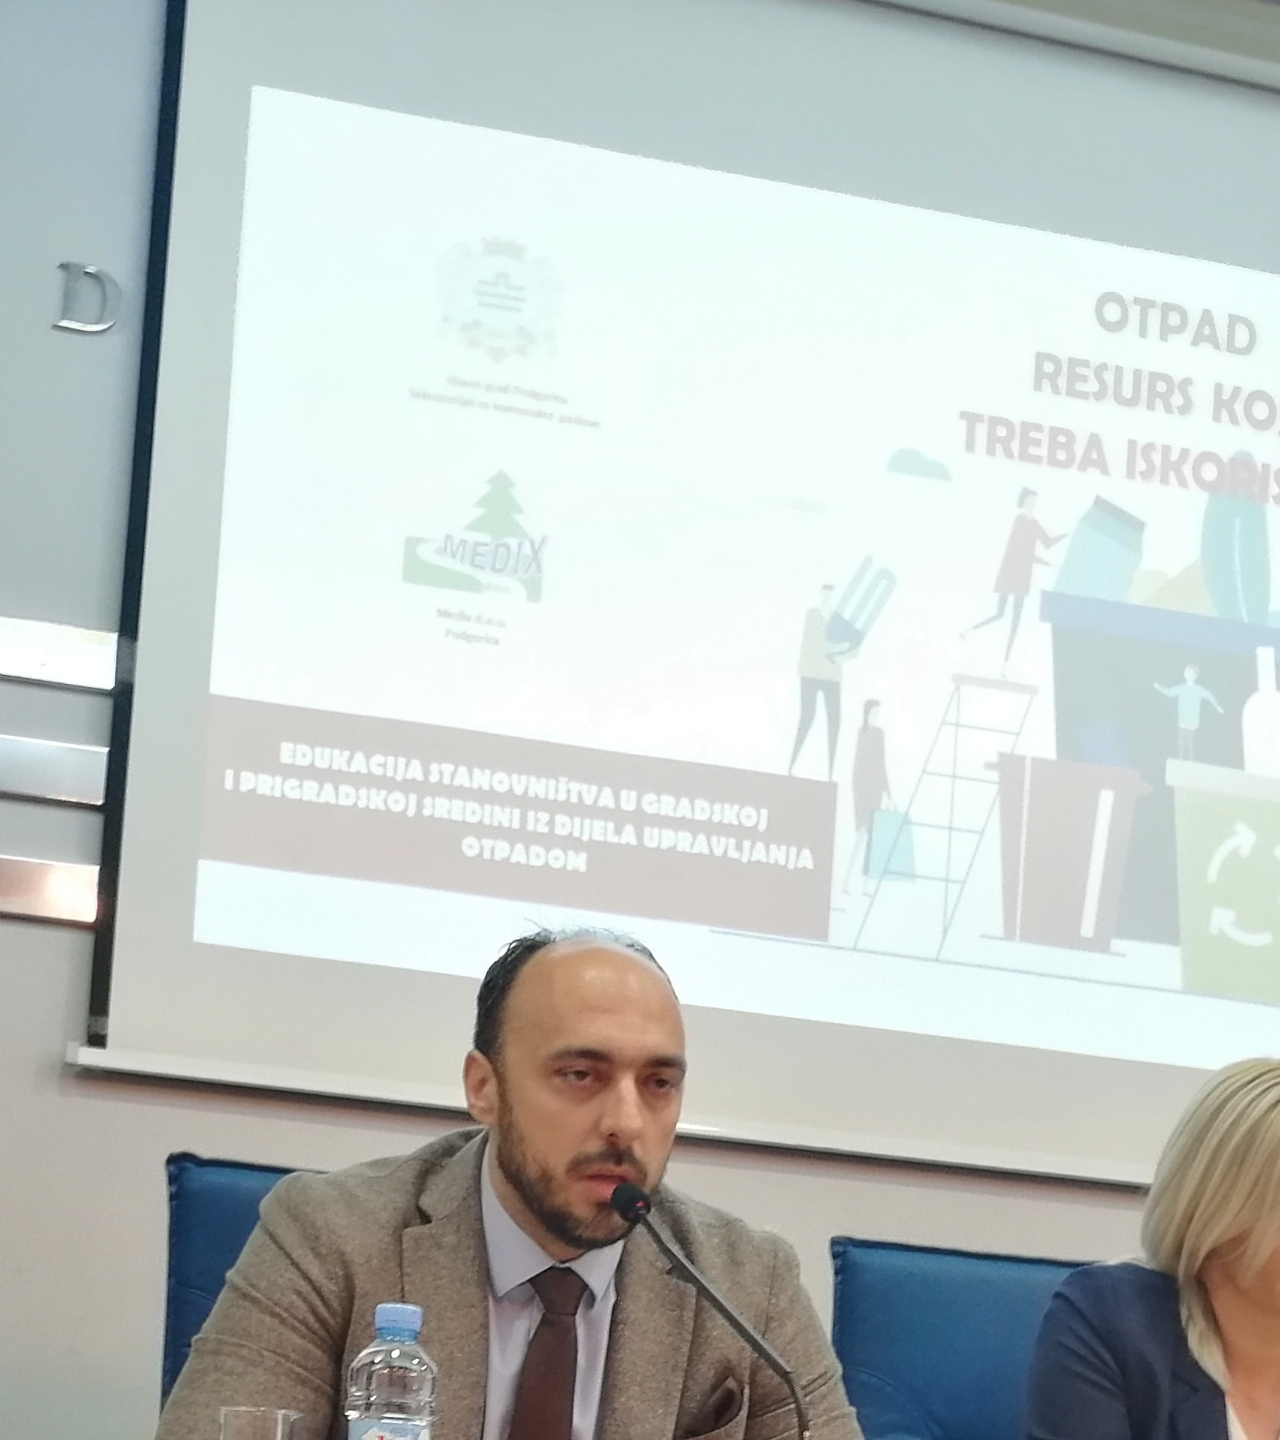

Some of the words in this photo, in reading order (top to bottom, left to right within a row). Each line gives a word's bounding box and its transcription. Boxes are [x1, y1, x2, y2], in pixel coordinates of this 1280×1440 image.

[1094, 291, 1258, 356] OTPAD
[1032, 351, 1194, 416] RESURS
[959, 410, 1111, 477] TREBA
[442, 534, 548, 575] MEDIX
[278, 741, 425, 782] EDUKACIJA
[428, 762, 616, 809] STANOVNIŠTVA
[619, 789, 639, 812] U
[640, 793, 770, 832] GRADSKOJ
[224, 768, 235, 791] I
[239, 770, 418, 818] PRIGRADSKOJ
[422, 796, 522, 830] SREDINI
[526, 810, 551, 834] IZ
[553, 814, 639, 846] DIJELA
[642, 827, 816, 871] UPRAVLJANJA
[461, 835, 588, 873] OTPADOM
